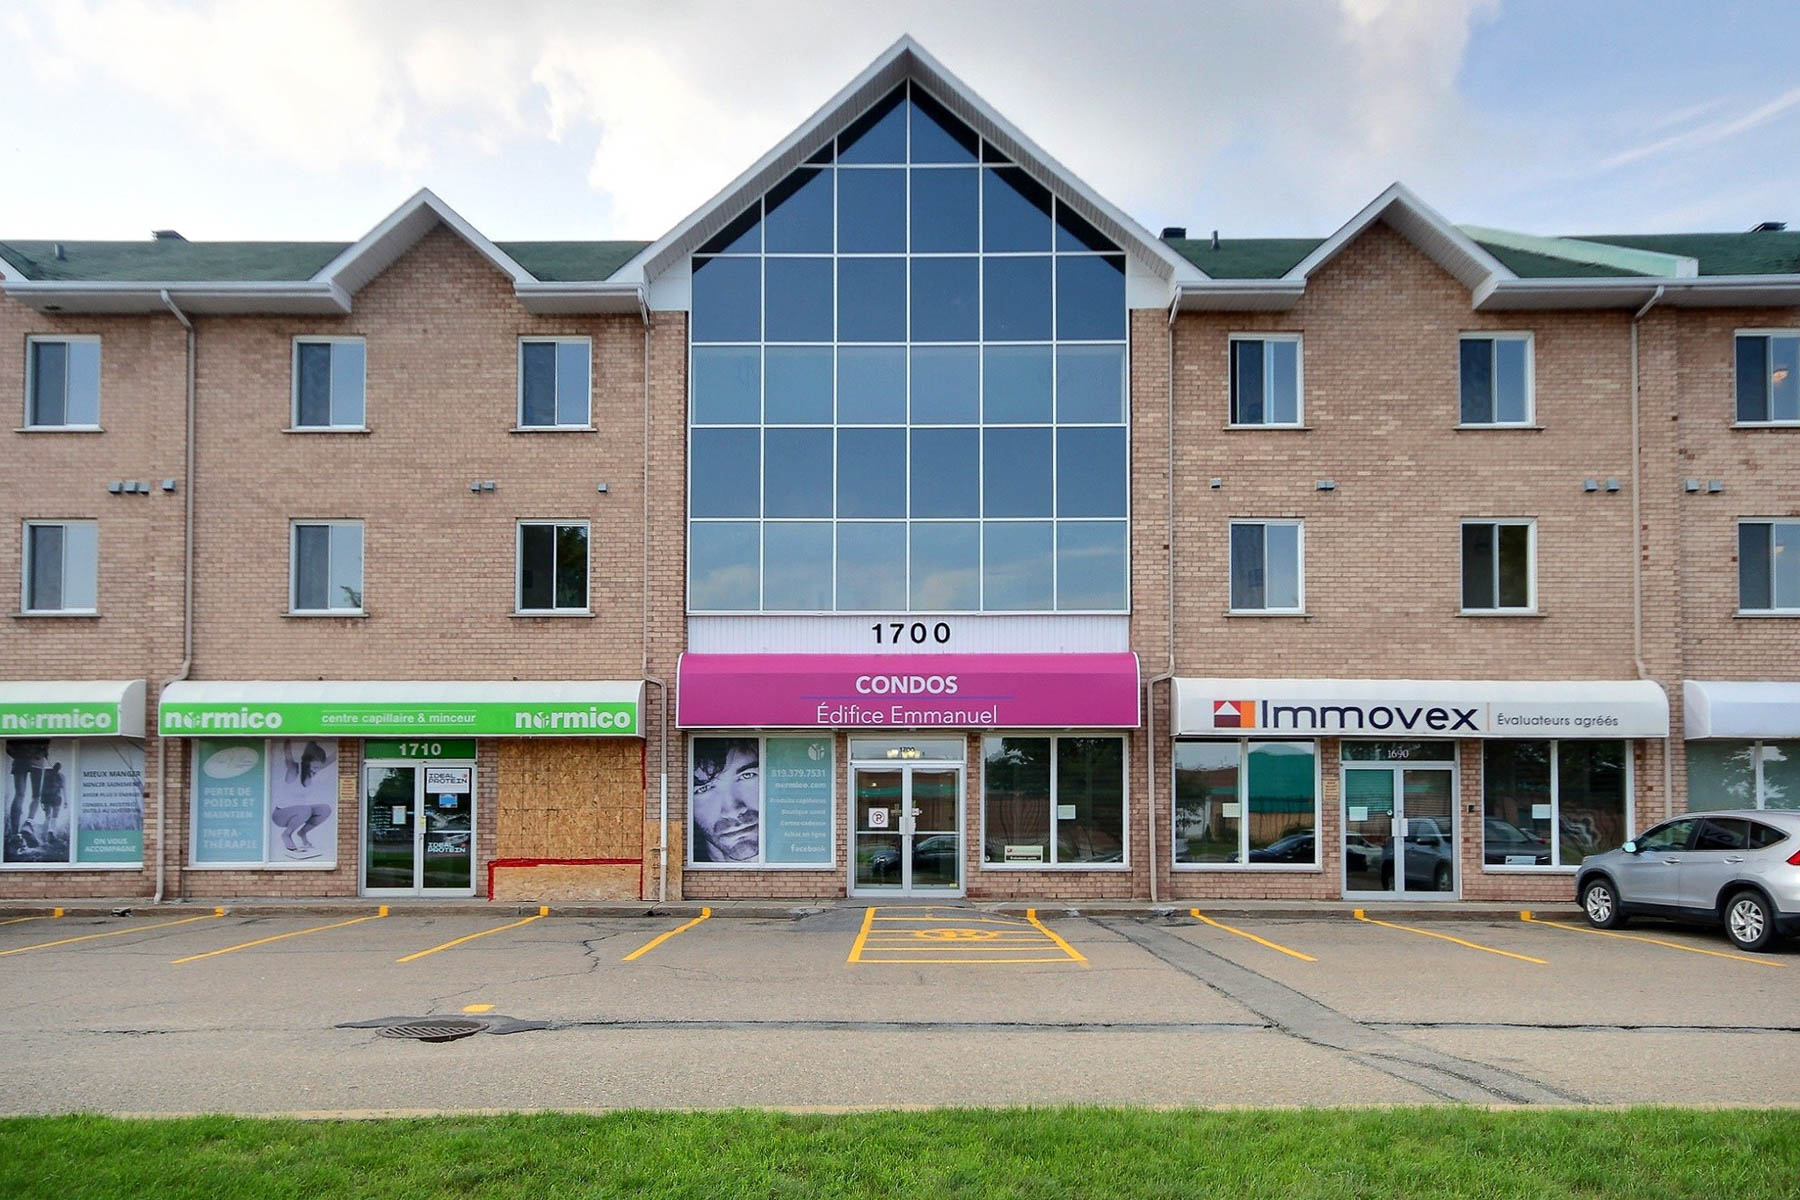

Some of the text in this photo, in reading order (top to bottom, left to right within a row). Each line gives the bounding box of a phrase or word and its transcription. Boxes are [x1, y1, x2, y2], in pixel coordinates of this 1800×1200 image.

[871, 622, 951, 644] 1700
[855, 675, 958, 695] CONDOS
[165, 707, 282, 729] normico
[321, 713, 476, 725] centre capillaire & minceur
[515, 707, 631, 729] normico
[817, 702, 997, 723] Édifice Emmanuel
[1262, 700, 1480, 731] Immovex
[1497, 712, 1619, 727] Évaluateurs agréés
[398, 743, 442, 756] 1710
[1388, 749, 1409, 759] 1690
[204, 787, 251, 796] PERTE DE
[204, 798, 254, 807] POIDS ET
